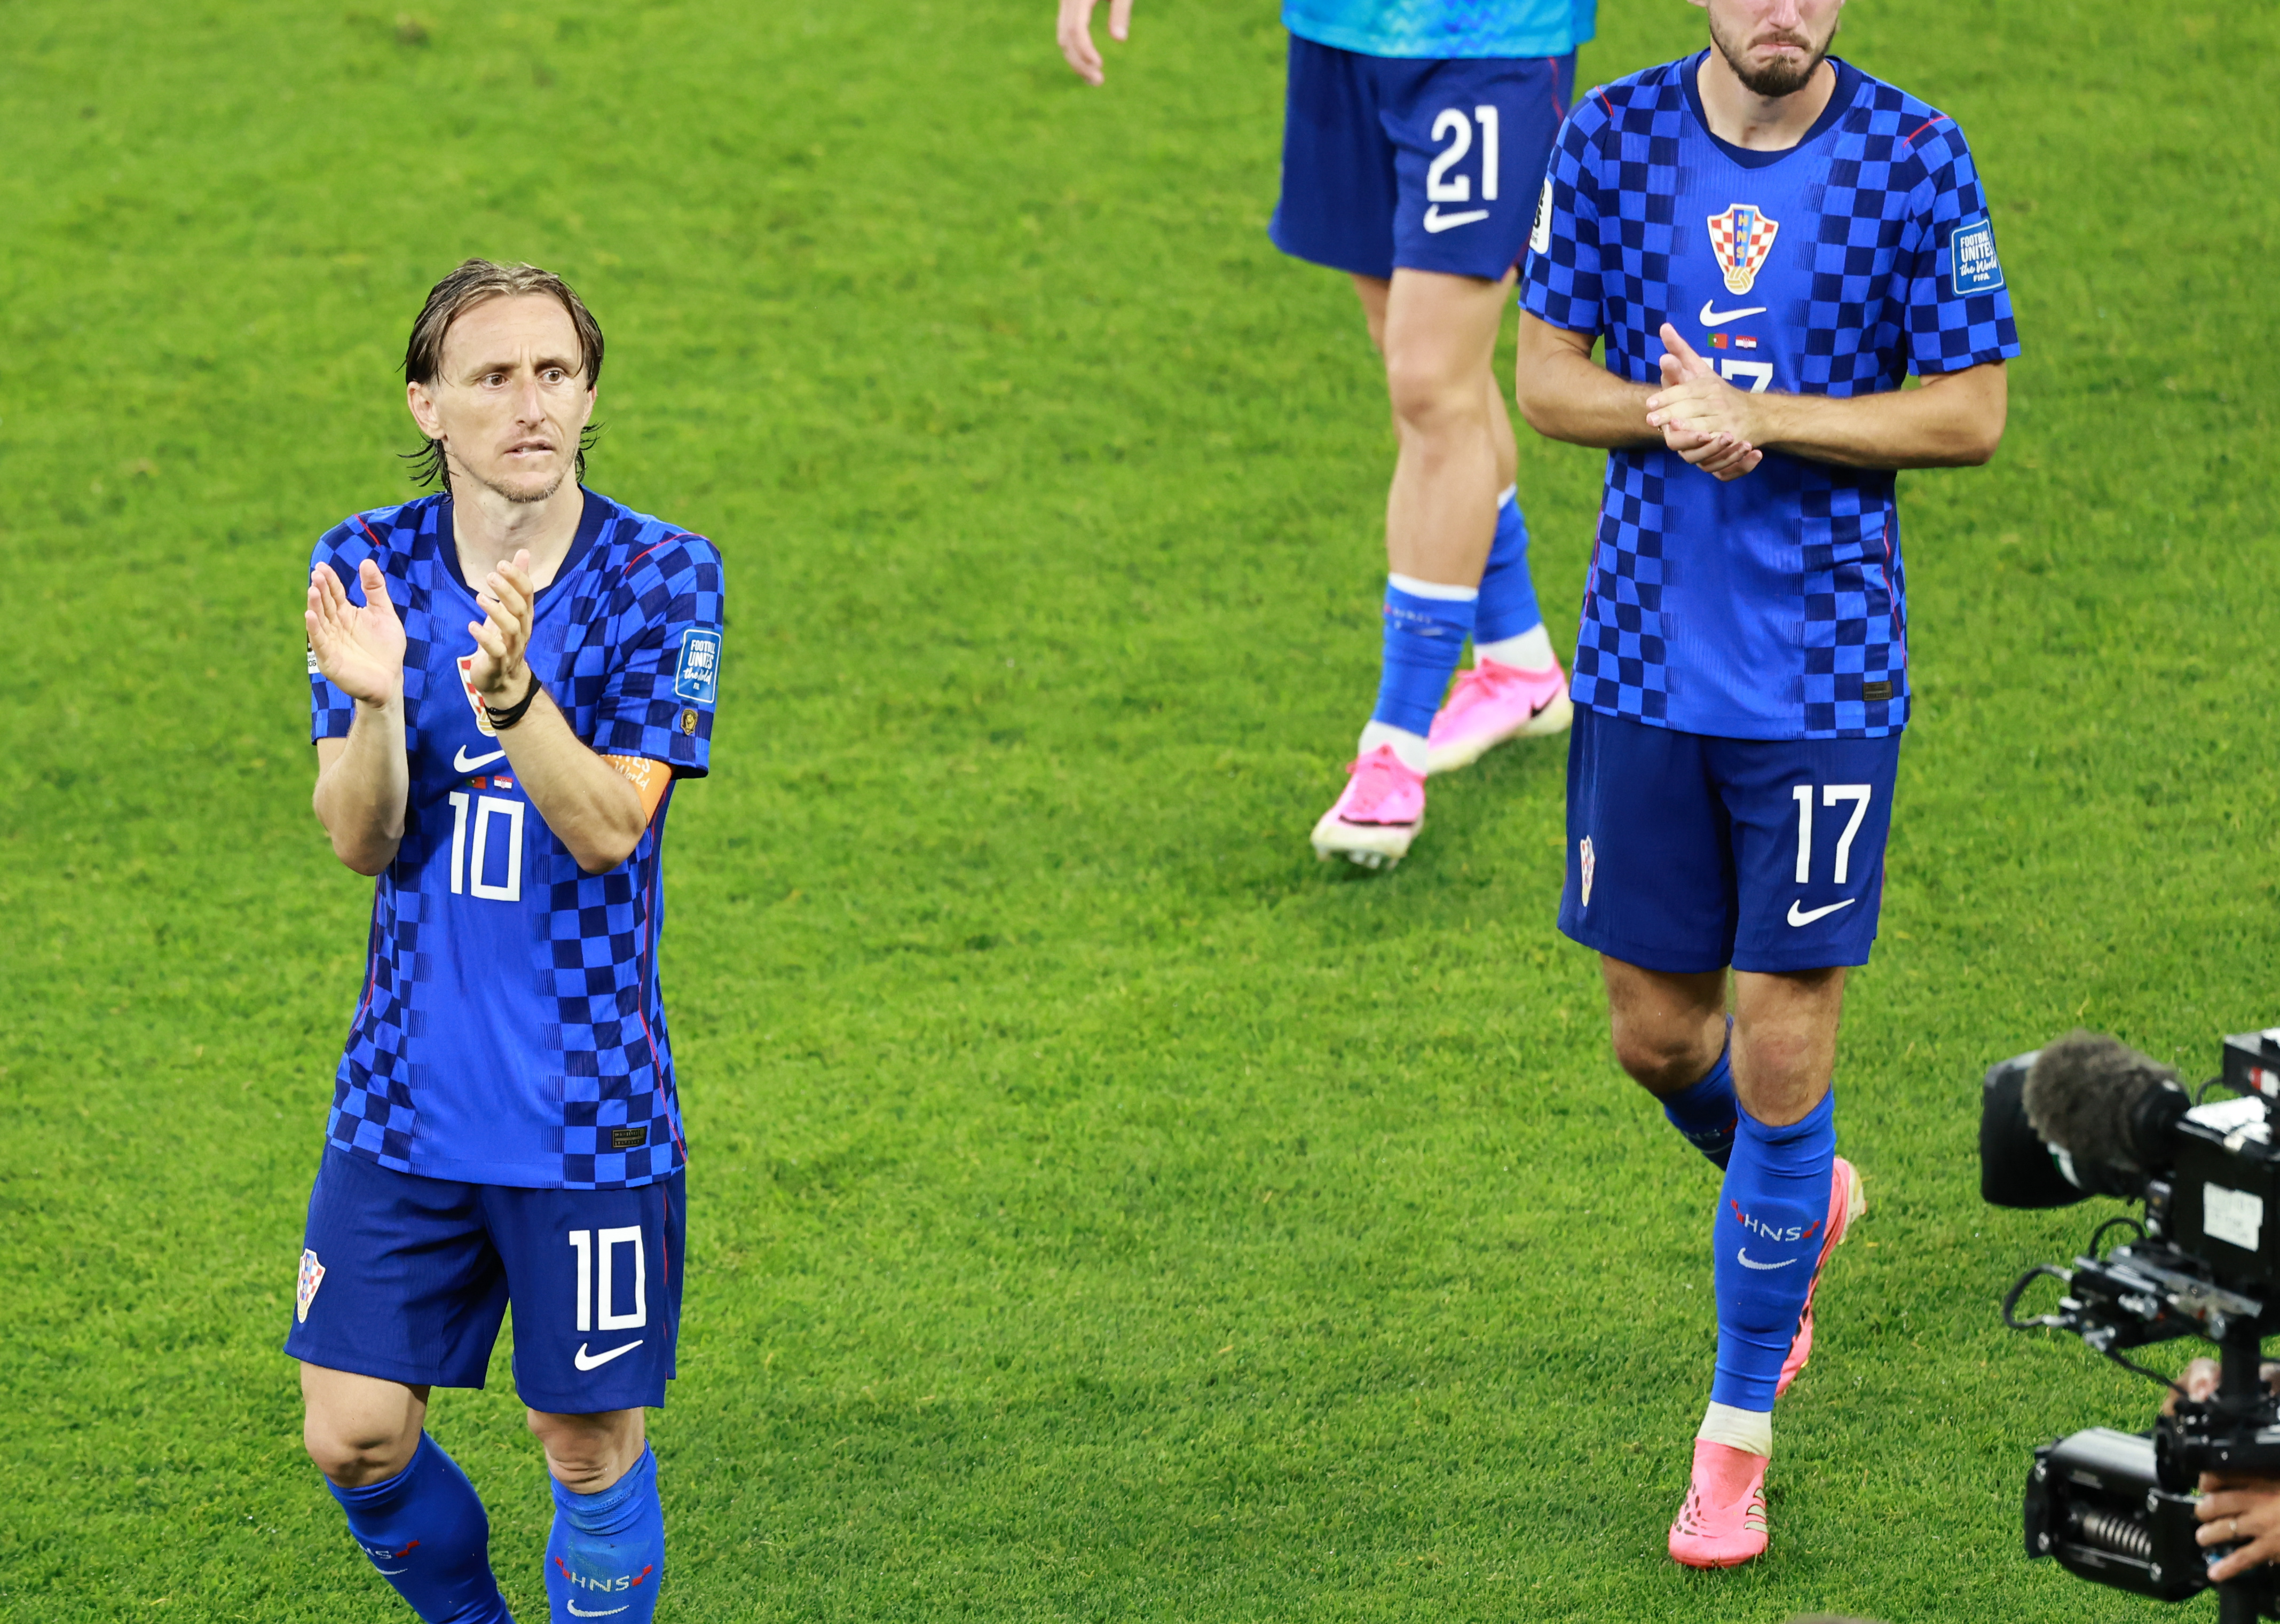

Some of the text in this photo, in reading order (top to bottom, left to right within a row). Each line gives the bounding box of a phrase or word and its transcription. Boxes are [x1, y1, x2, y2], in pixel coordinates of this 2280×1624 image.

[1427, 105, 1498, 202] 21
[1736, 214, 1749, 259] HNS
[1959, 255, 1998, 277] the World
[1703, 357, 1773, 393] 7
[690, 639, 715, 655] FOOTBLL
[683, 667, 698, 680] the
[449, 791, 525, 902] 10
[1793, 784, 1872, 884] 17
[1744, 1213, 1802, 1242] HNS
[569, 1225, 646, 1331] 10
[571, 1572, 630, 1593] HNS
